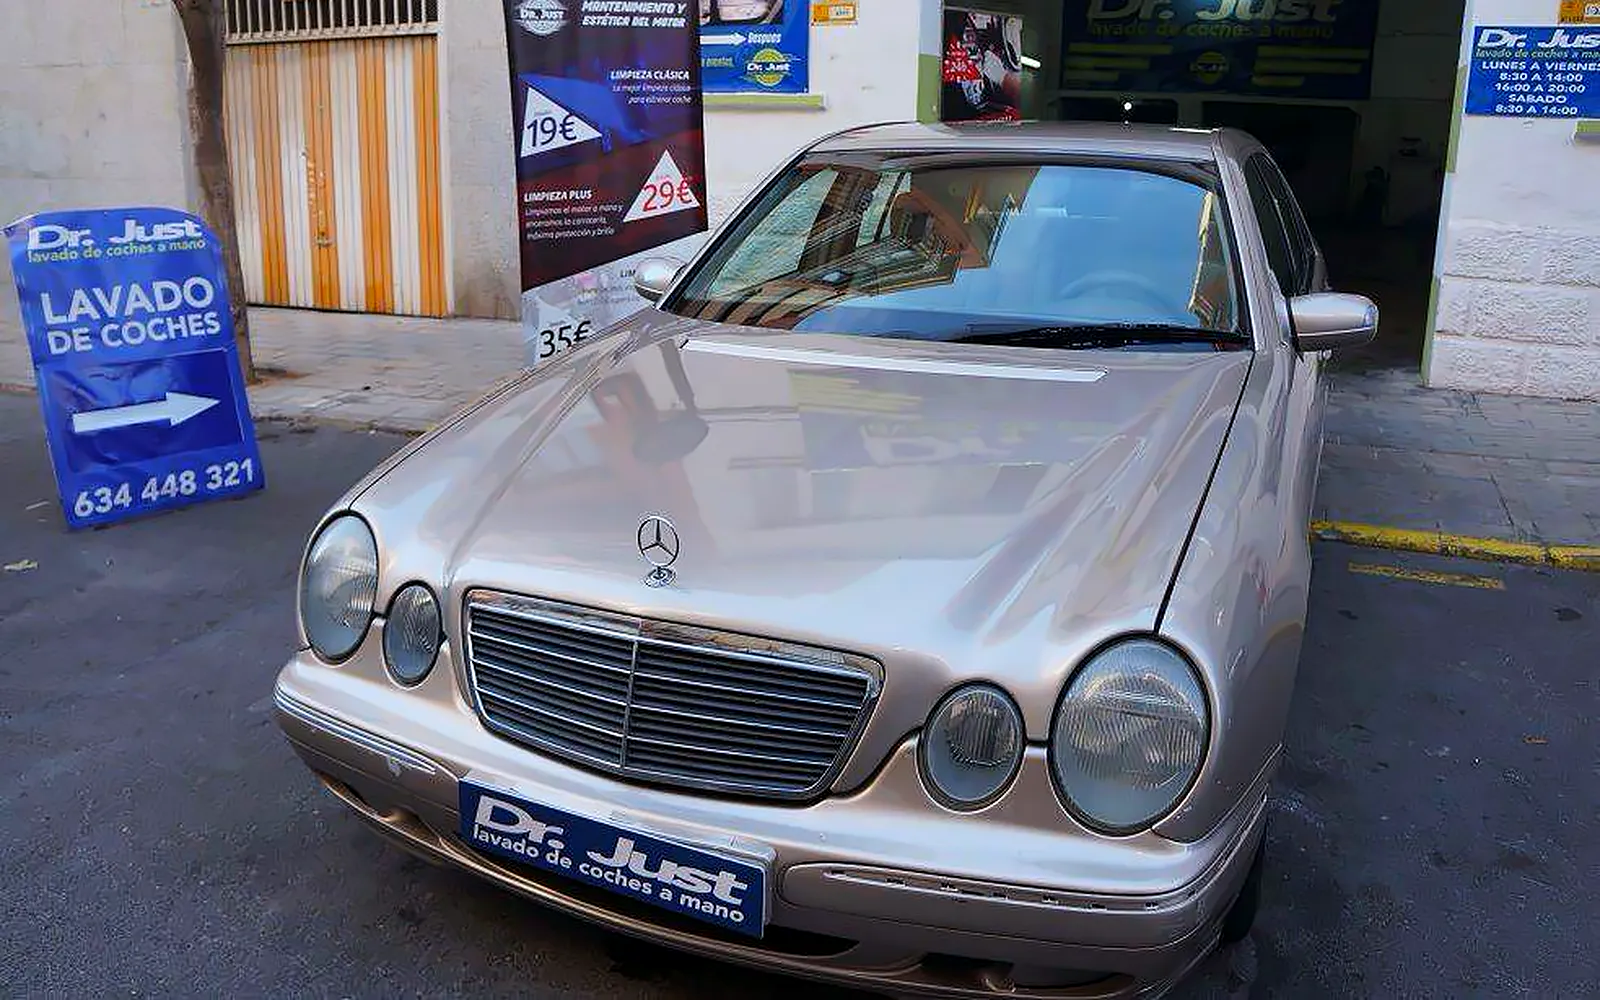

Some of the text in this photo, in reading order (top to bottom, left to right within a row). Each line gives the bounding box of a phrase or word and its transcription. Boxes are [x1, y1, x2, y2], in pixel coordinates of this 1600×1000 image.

[581, 1, 687, 13] MANTENIMIENTO Y
[582, 13, 687, 27] ESTÉTICA DEL MOTOR
[1477, 29, 1528, 48] Dr.
[1475, 49, 1512, 58] lavado
[1514, 49, 1529, 58] de
[1531, 49, 1568, 58] coches
[610, 69, 690, 80] LIMPIEZA CLÁSICA
[1482, 61, 1600, 71] LUNES A VIERNES
[1499, 72, 1583, 82] 8:30 A 14:00
[1495, 83, 1586, 93] 16:00 A 20:00
[1508, 94, 1567, 104] SABADO
[1495, 104, 1578, 115] 8:30 A 14:00
[526, 115, 577, 147] 19€
[524, 189, 593, 202] LIMPIEZA PLUS
[643, 180, 693, 212] 29€
[27, 219, 203, 251] Dr. Just
[28, 239, 206, 263] lavado de coches a mano
[40, 276, 215, 325] LAVADO
[47, 311, 221, 355] DE COCHES
[539, 320, 592, 358] 35€
[74, 457, 254, 517] 634 448 321
[473, 794, 749, 906] Dr. Just
[472, 823, 745, 924] lavado de coches a mano
